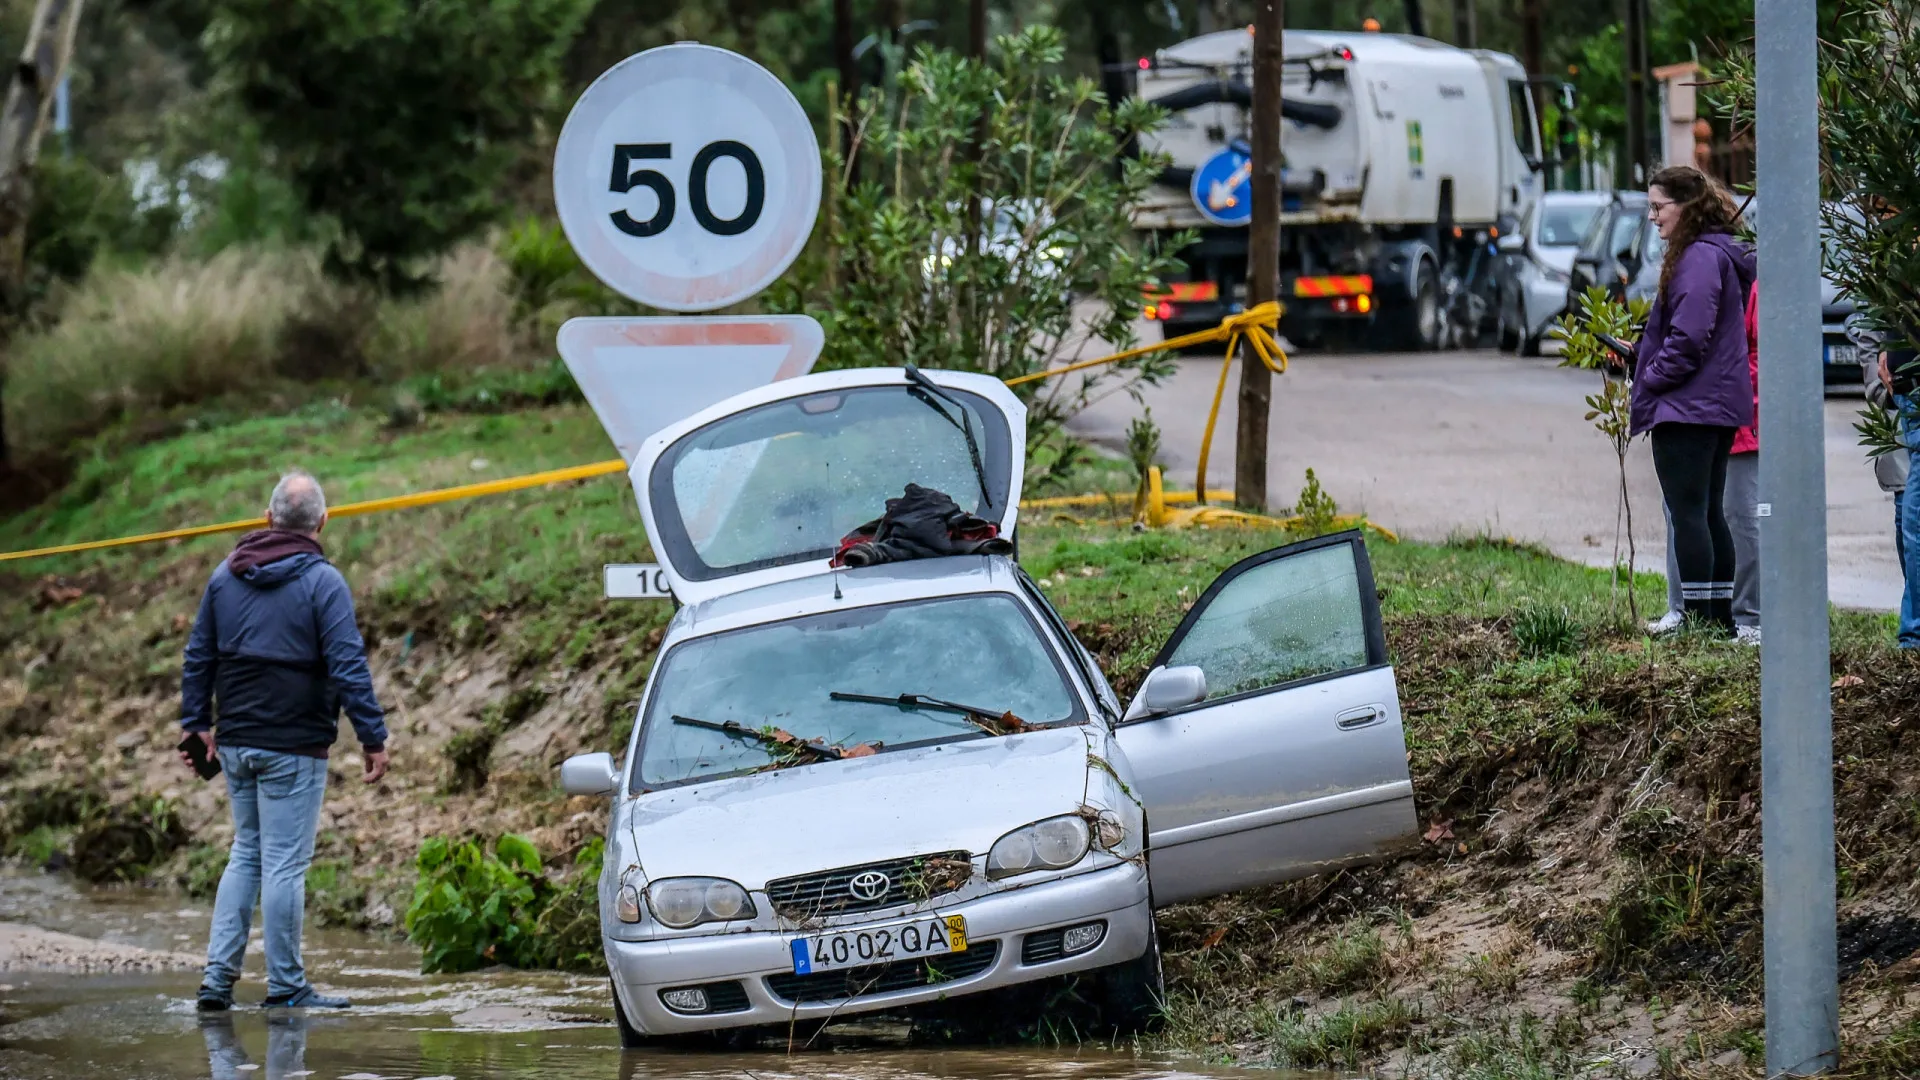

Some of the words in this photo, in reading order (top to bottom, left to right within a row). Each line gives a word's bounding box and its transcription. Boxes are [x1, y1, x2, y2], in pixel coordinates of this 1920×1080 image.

[609, 140, 765, 237] 50
[952, 936, 965, 947] 07
[799, 960, 806, 968] P
